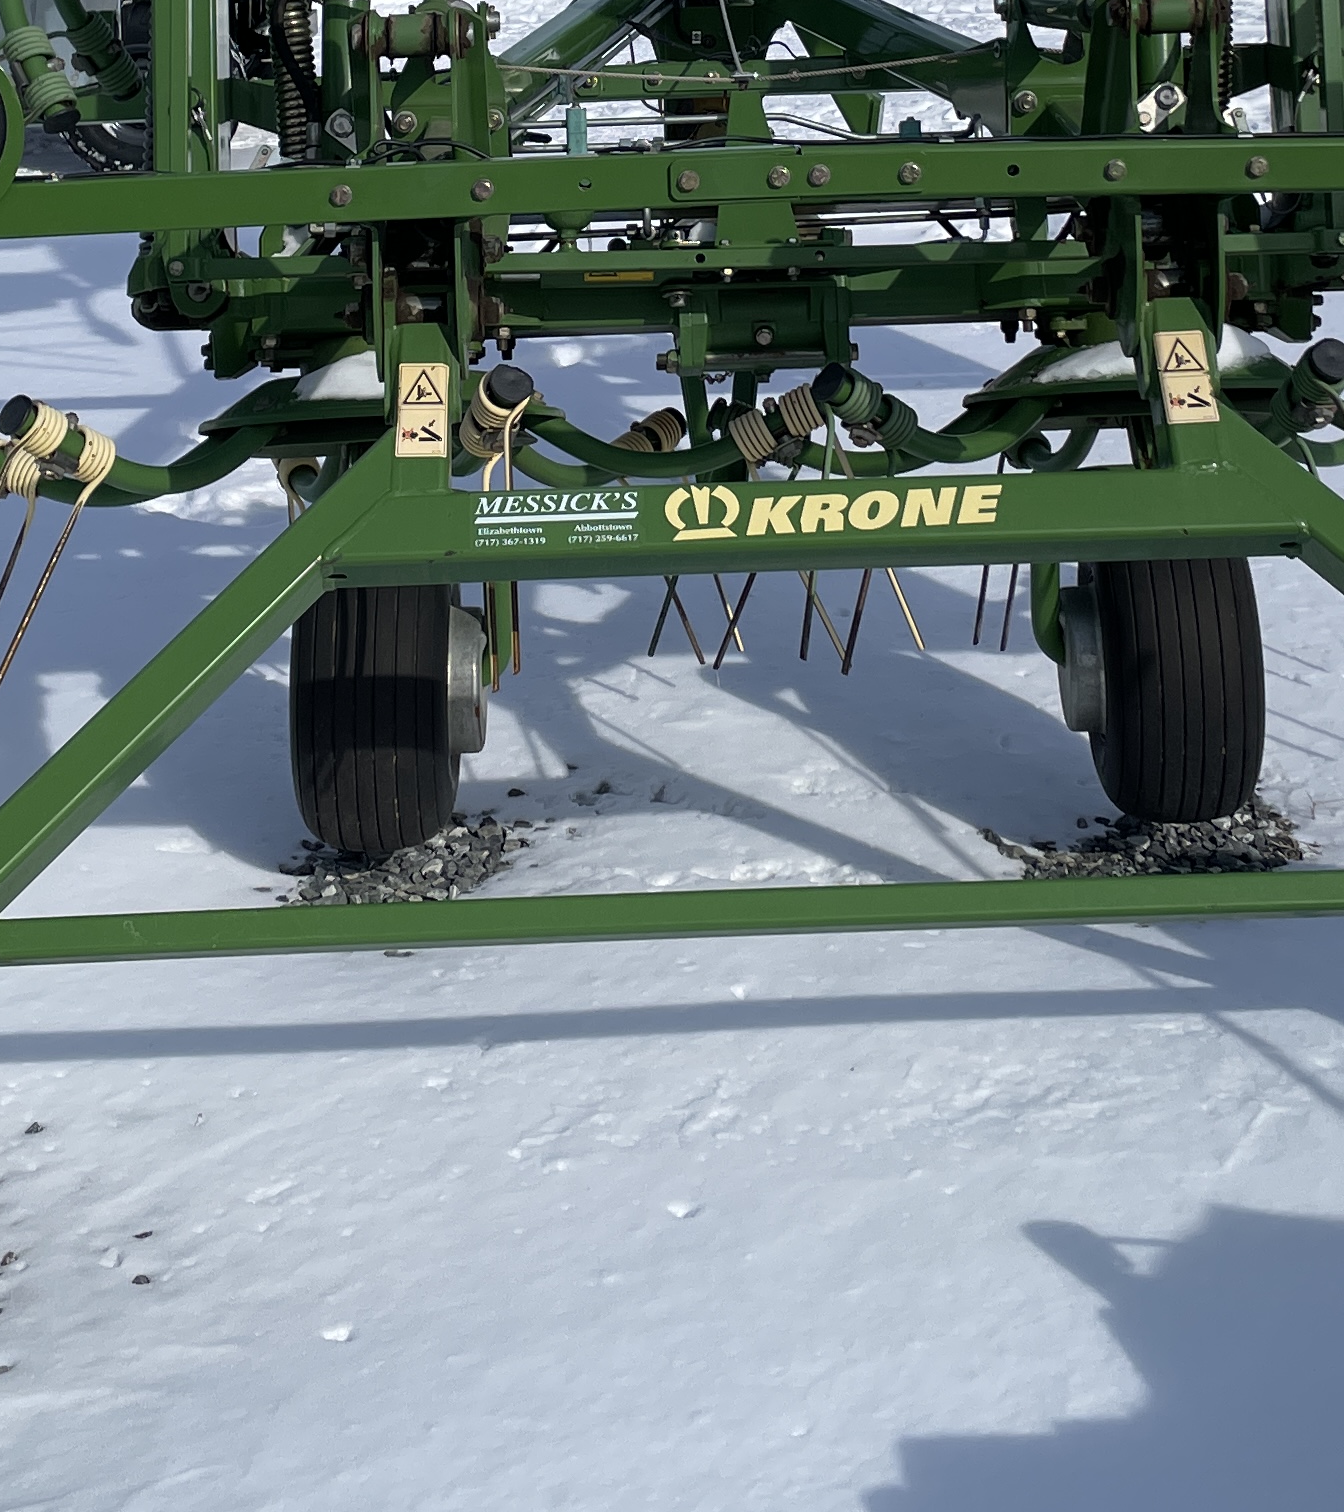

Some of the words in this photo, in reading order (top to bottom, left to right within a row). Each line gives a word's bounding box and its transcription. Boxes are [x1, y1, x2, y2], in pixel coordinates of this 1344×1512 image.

[474, 491, 638, 515] MESSICK'S
[745, 484, 1003, 537] KRONE
[477, 526, 543, 536] Elizabethtown
[573, 523, 633, 532] Abbottstown
[474, 538, 500, 548] (717)
[502, 536, 547, 547] 367-1319
[567, 534, 593, 544] (717)
[595, 533, 639, 543] 259-6617
